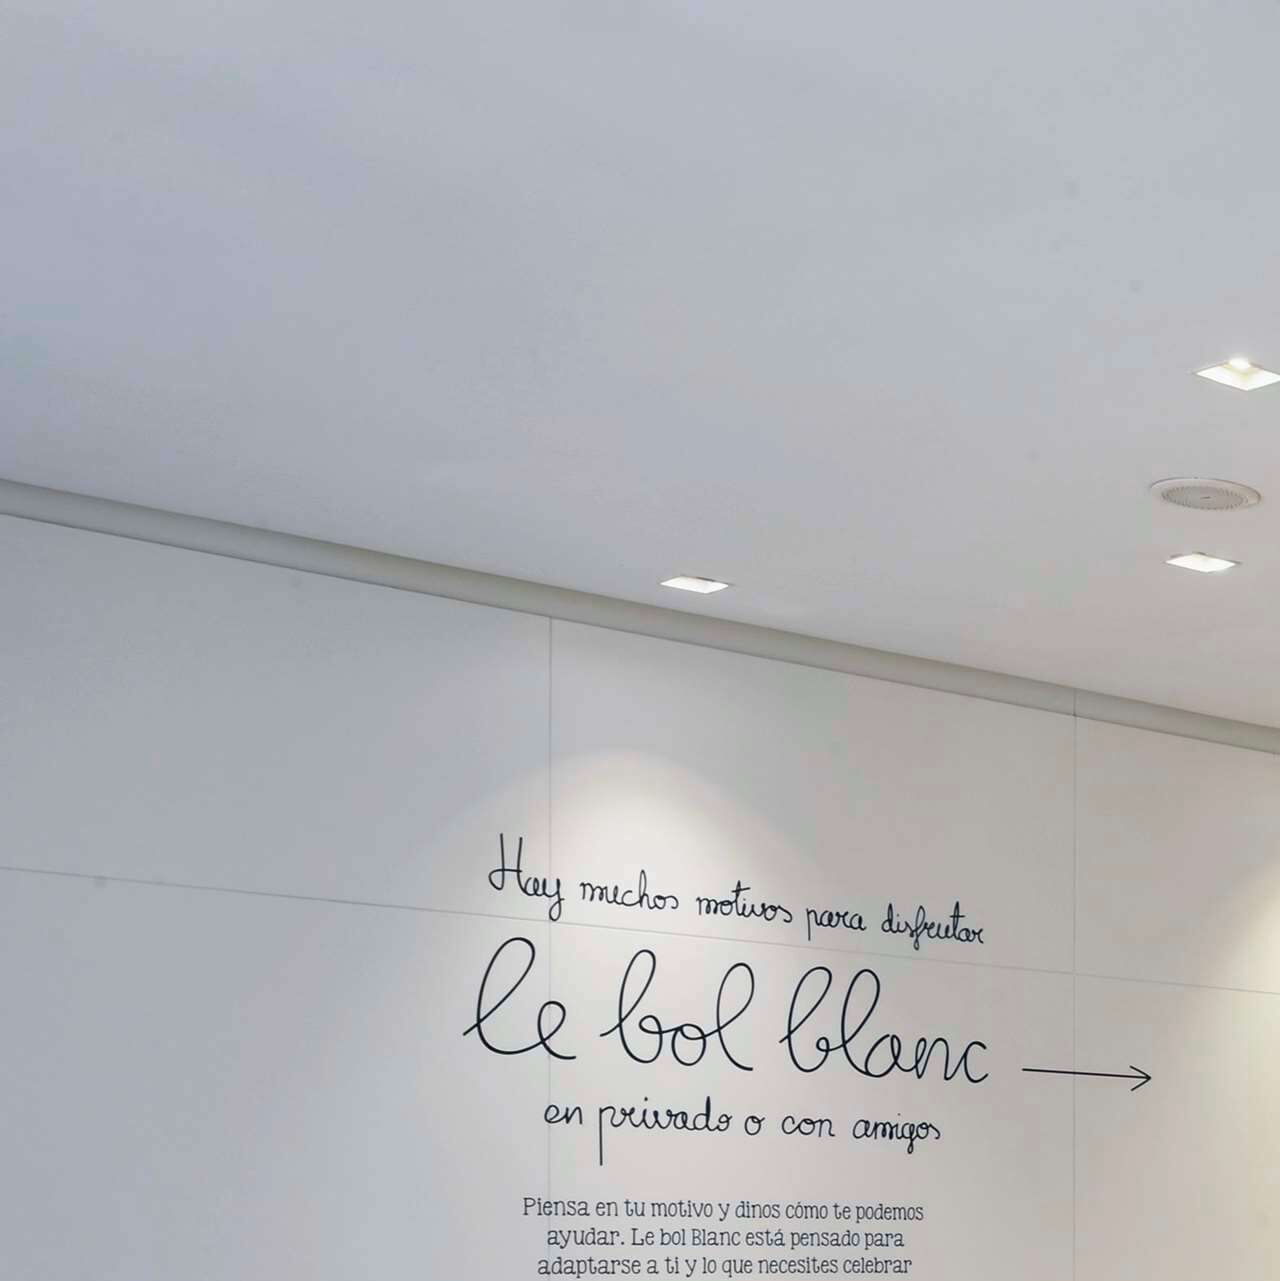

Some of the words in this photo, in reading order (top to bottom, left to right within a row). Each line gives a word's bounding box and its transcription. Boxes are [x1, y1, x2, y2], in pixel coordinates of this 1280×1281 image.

[488, 833, 565, 922] Hay
[695, 879, 793, 924] motivos
[805, 907, 867, 942] para
[881, 901, 985, 951] disfrutar
[600, 950, 753, 1072] bol
[779, 966, 990, 1083] blanc
[544, 1103, 584, 1126] en
[598, 1097, 734, 1166] privado
[743, 1112, 764, 1137] o
[781, 1115, 836, 1139] con
[852, 1116, 942, 1155] amigos
[523, 1197, 590, 1216] Piensa
[595, 1201, 618, 1216] en
[624, 1199, 645, 1217] tu
[651, 1200, 713, 1218] motivo
[718, 1203, 730, 1222] y
[735, 1201, 781, 1219] dinos
[785, 1202, 828, 1219] cómo
[832, 1203, 851, 1220] te
[856, 1203, 924, 1224] podemos
[547, 1227, 625, 1249] ayudar.
[631, 1228, 655, 1246] Le
[660, 1228, 686, 1246] bol
[691, 1228, 741, 1246] Blanc
[743, 1228, 786, 1248] está
[790, 1229, 861, 1250] pensado
[863, 1232, 904, 1251] para
[538, 1256, 641, 1279] adaptarse
[647, 1259, 659, 1274] a
[664, 1256, 680, 1274] ti
[685, 1259, 697, 1278] y
[702, 1257, 720, 1274] lo
[722, 1259, 753, 1278] que
[757, 1256, 838, 1274] necesites
[843, 1256, 912, 1273] celebrar
